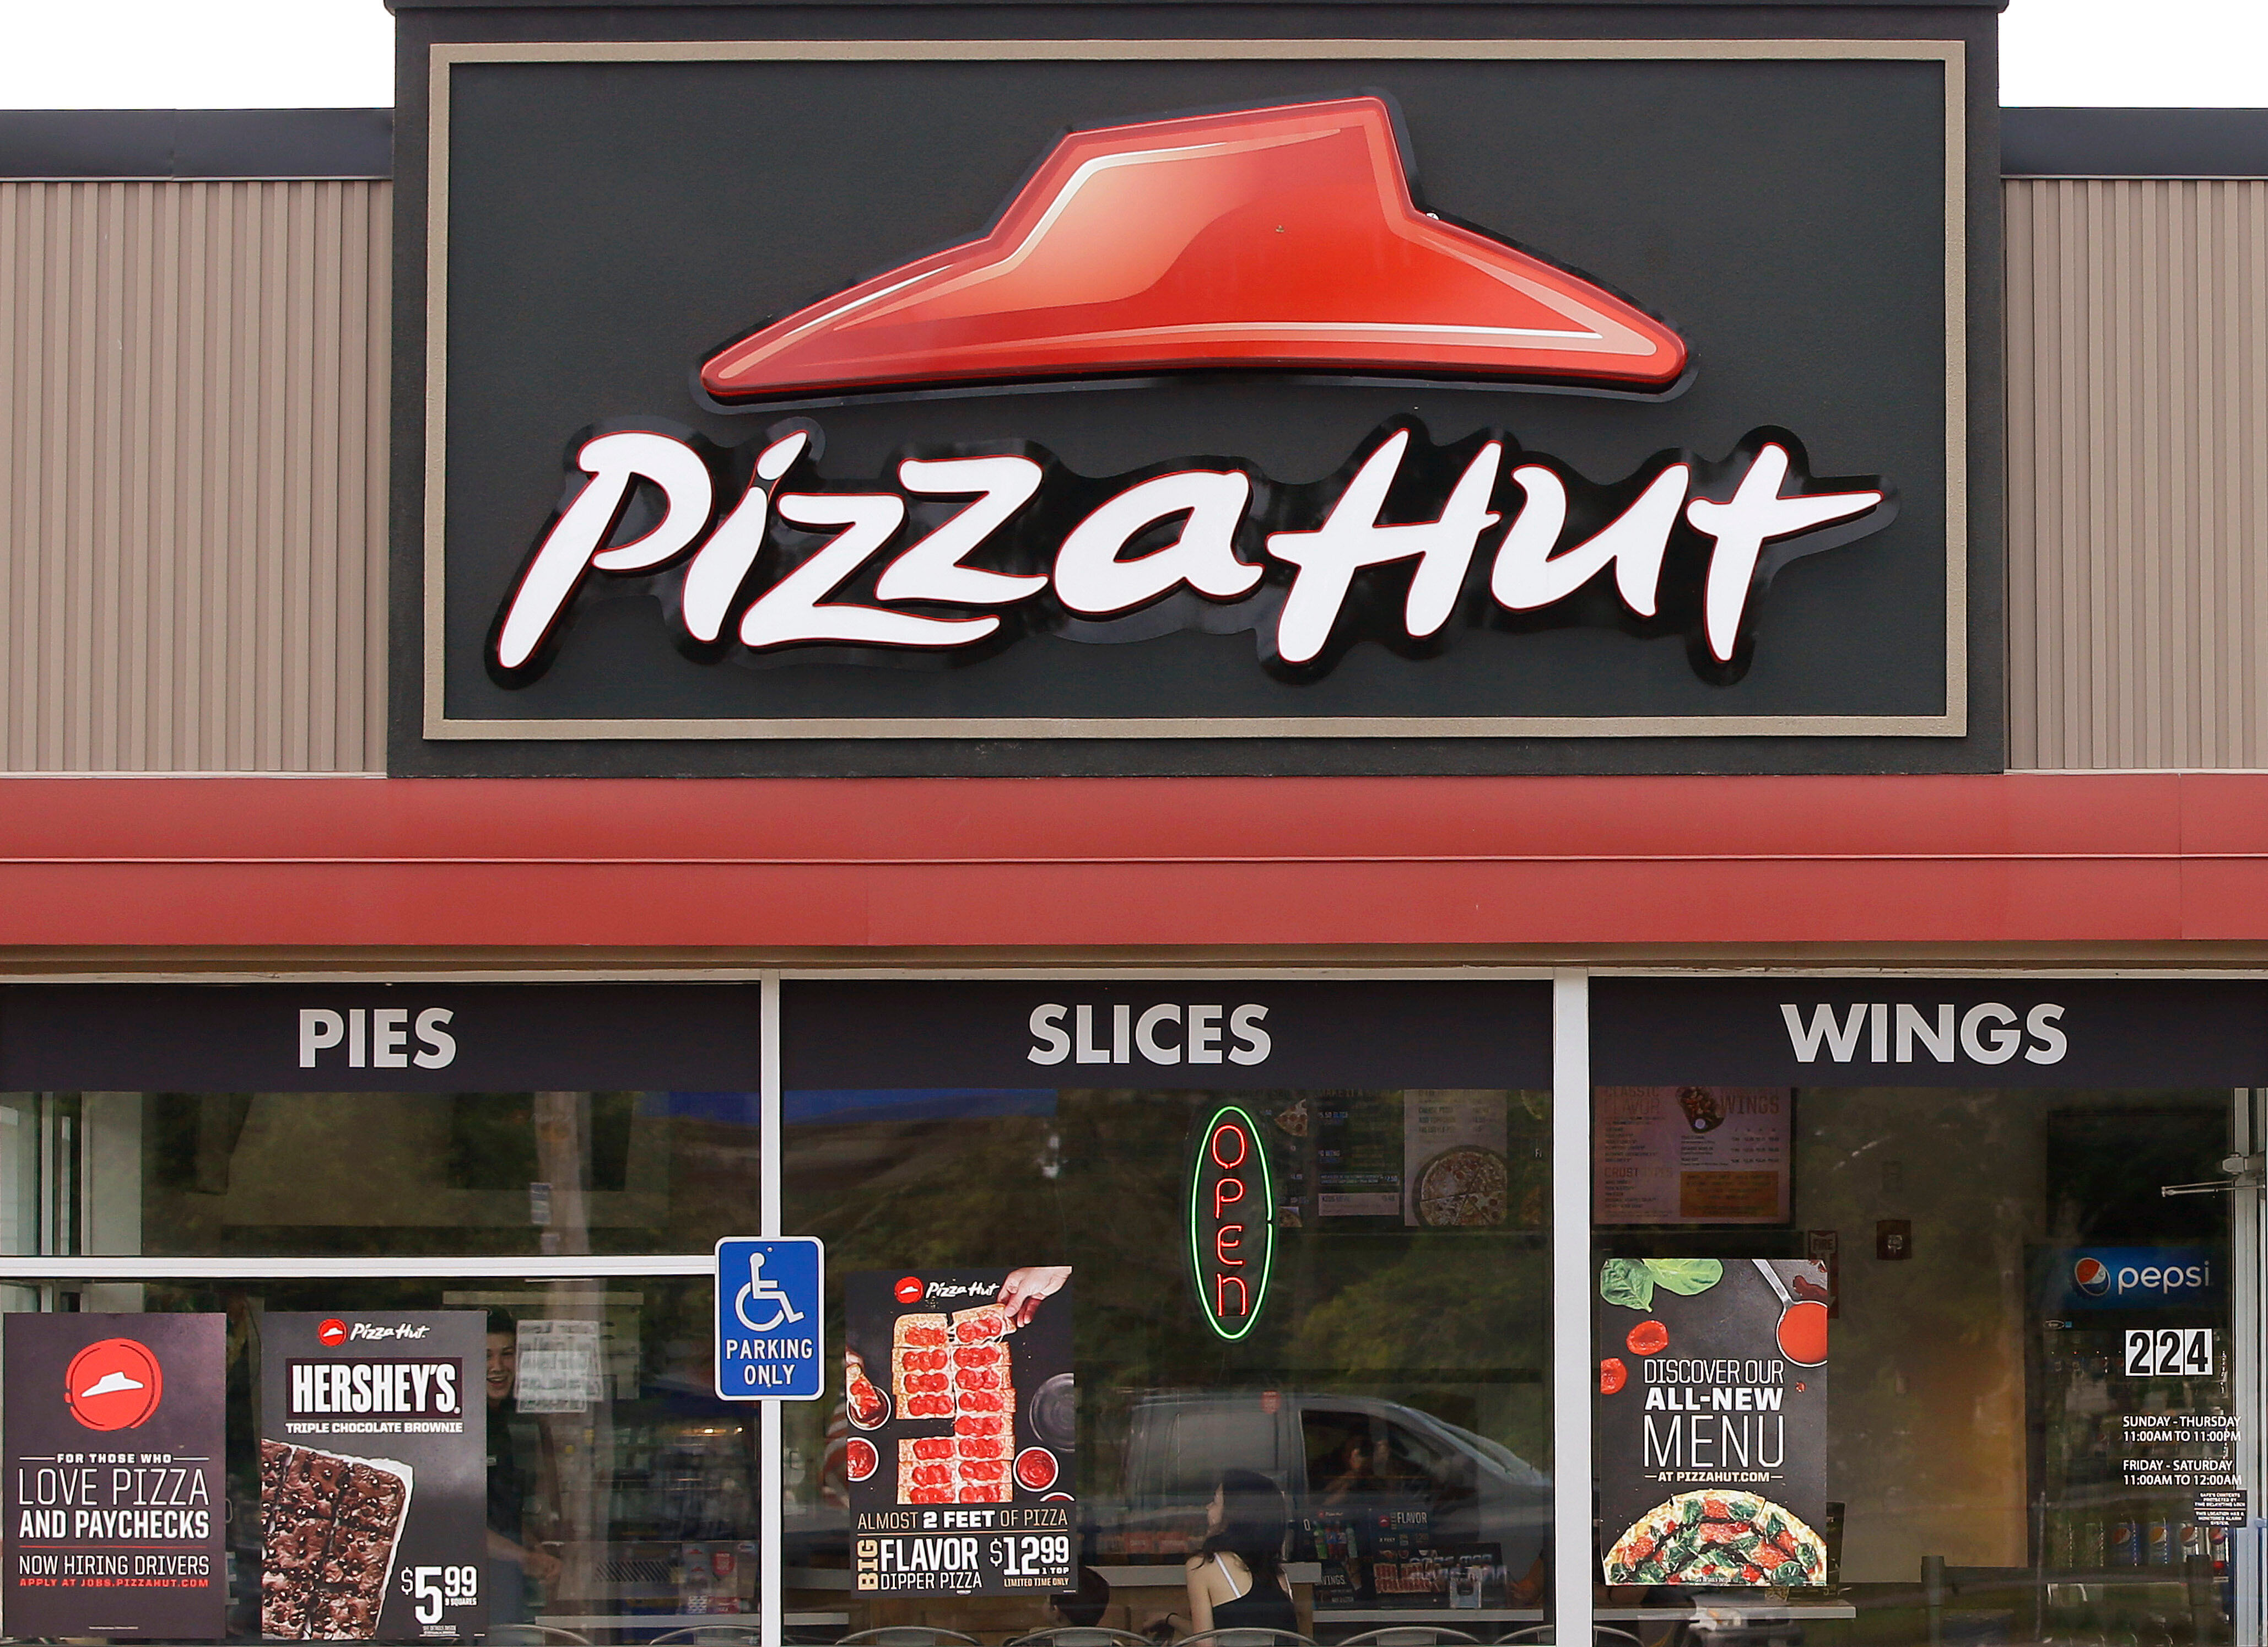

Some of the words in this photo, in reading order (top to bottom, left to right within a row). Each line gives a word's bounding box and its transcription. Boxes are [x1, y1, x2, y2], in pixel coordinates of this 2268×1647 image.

[496, 426, 1265, 669] Pizza
[1264, 426, 1883, 665] Hut
[299, 1007, 456, 1069] PIES
[1027, 1003, 1271, 1066] SLICES
[1780, 1002, 2067, 1065] WINGS
[2118, 1261, 2209, 1295] pepsi
[926, 1282, 968, 1299] Pizza
[968, 1281, 1000, 1297] Hut
[350, 1323, 395, 1341] Pizza
[726, 1338, 812, 1359] PARKING
[2129, 1332, 2208, 1374] 224
[744, 1364, 795, 1385] ONLY
[1644, 1359, 1740, 1384] DISCOVER
[1745, 1359, 1784, 1384] OUR
[1645, 1387, 1783, 1411] ALL-NEW
[285, 1423, 330, 1434] TRIPLE
[331, 1422, 402, 1433] CHOCOLATE
[404, 1422, 463, 1433] BROWNIE
[2123, 1416, 2170, 1427] SUNDAY
[2178, 1414, 2242, 1427] THURSDAY
[1644, 1414, 1784, 1467] MENU
[2124, 1430, 2173, 1441] 11:00AM
[2174, 1430, 2190, 1441] TO
[2193, 1430, 2242, 1442] 11:00PM
[57, 1454, 84, 1464] FOR
[89, 1454, 135, 1464] THOSE
[141, 1454, 171, 1464] WHO
[2123, 1460, 2163, 1471] FRIDAY
[2172, 1459, 2233, 1471] SATURDAY
[19, 1468, 98, 1505] LOVE
[113, 1468, 209, 1505] PIZZA
[1657, 1471, 1673, 1482] AT
[1677, 1471, 1769, 1482] PIZZAHUT.COM
[2124, 1475, 2173, 1485] 11:00AM
[2174, 1474, 2190, 1485] TO
[2193, 1475, 2242, 1486] 12:00AM
[19, 1510, 66, 1538] AND
[75, 1510, 209, 1538] PAYCHECKS
[857, 1511, 919, 1530] ALMOST
[923, 1511, 937, 1529] 2
[943, 1510, 995, 1528] FEET
[1000, 1509, 1019, 1527] OF
[1024, 1509, 1068, 1526] PIZZA
[1397, 1511, 1427, 1524] FLAVOR
[19, 1555, 58, 1575] NOW
[64, 1555, 128, 1575] HIRING
[135, 1556, 209, 1575] DRIVERS
[857, 1540, 878, 1590] BIG
[881, 1537, 979, 1572] FLAVOR
[1041, 1566, 1048, 1575] 1
[19, 1578, 58, 1587] APPLY
[80, 1578, 210, 1588] JOBS.PIZZAHUT.COM
[881, 1570, 935, 1590] DIPPER
[940, 1571, 982, 1589] PIZZA
[1004, 1578, 1033, 1587] LIMITED
[1033, 1578, 1051, 1586] TIME
[1052, 1577, 1069, 1586] ONLY
